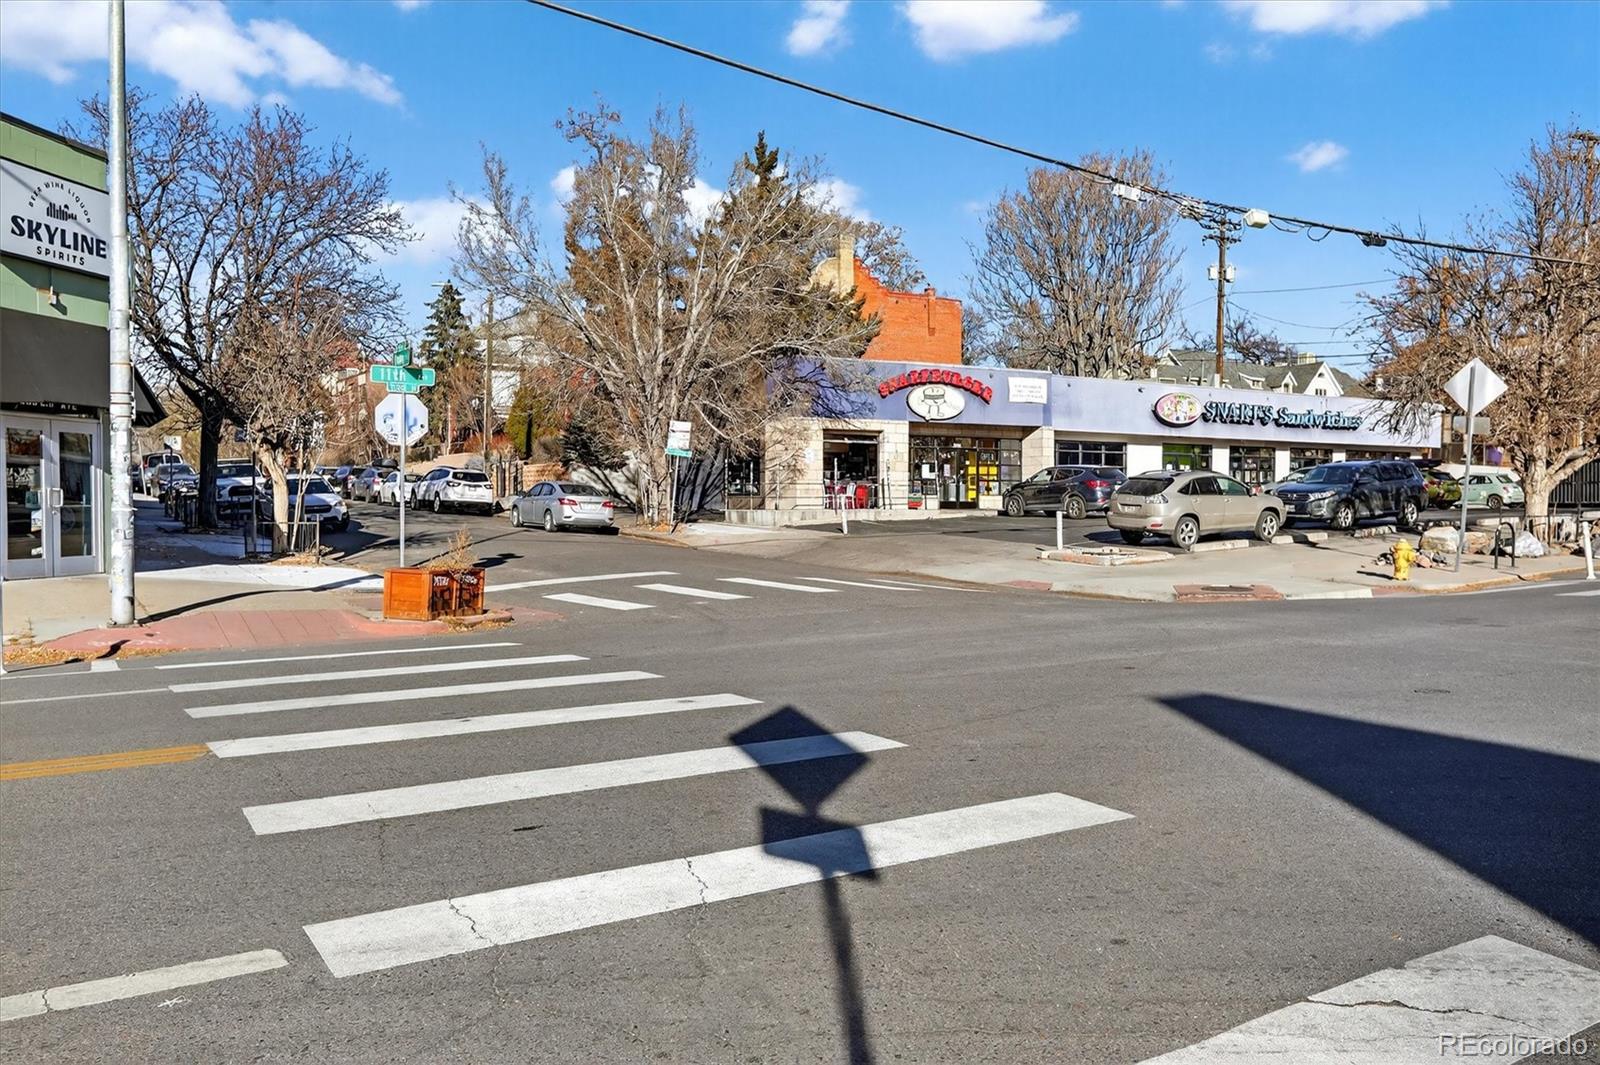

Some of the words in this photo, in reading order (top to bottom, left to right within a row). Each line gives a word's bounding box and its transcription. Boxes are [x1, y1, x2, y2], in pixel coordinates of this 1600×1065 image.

[28, 186, 43, 208] BEER
[44, 181, 65, 190] WINE
[68, 189, 91, 223] LIQUOR
[10, 214, 107, 259] SKYLINE
[36, 245, 86, 266] SPIRITS
[878, 369, 993, 404] SNARFBURGER
[1277, 406, 1364, 430] Sandwiches
